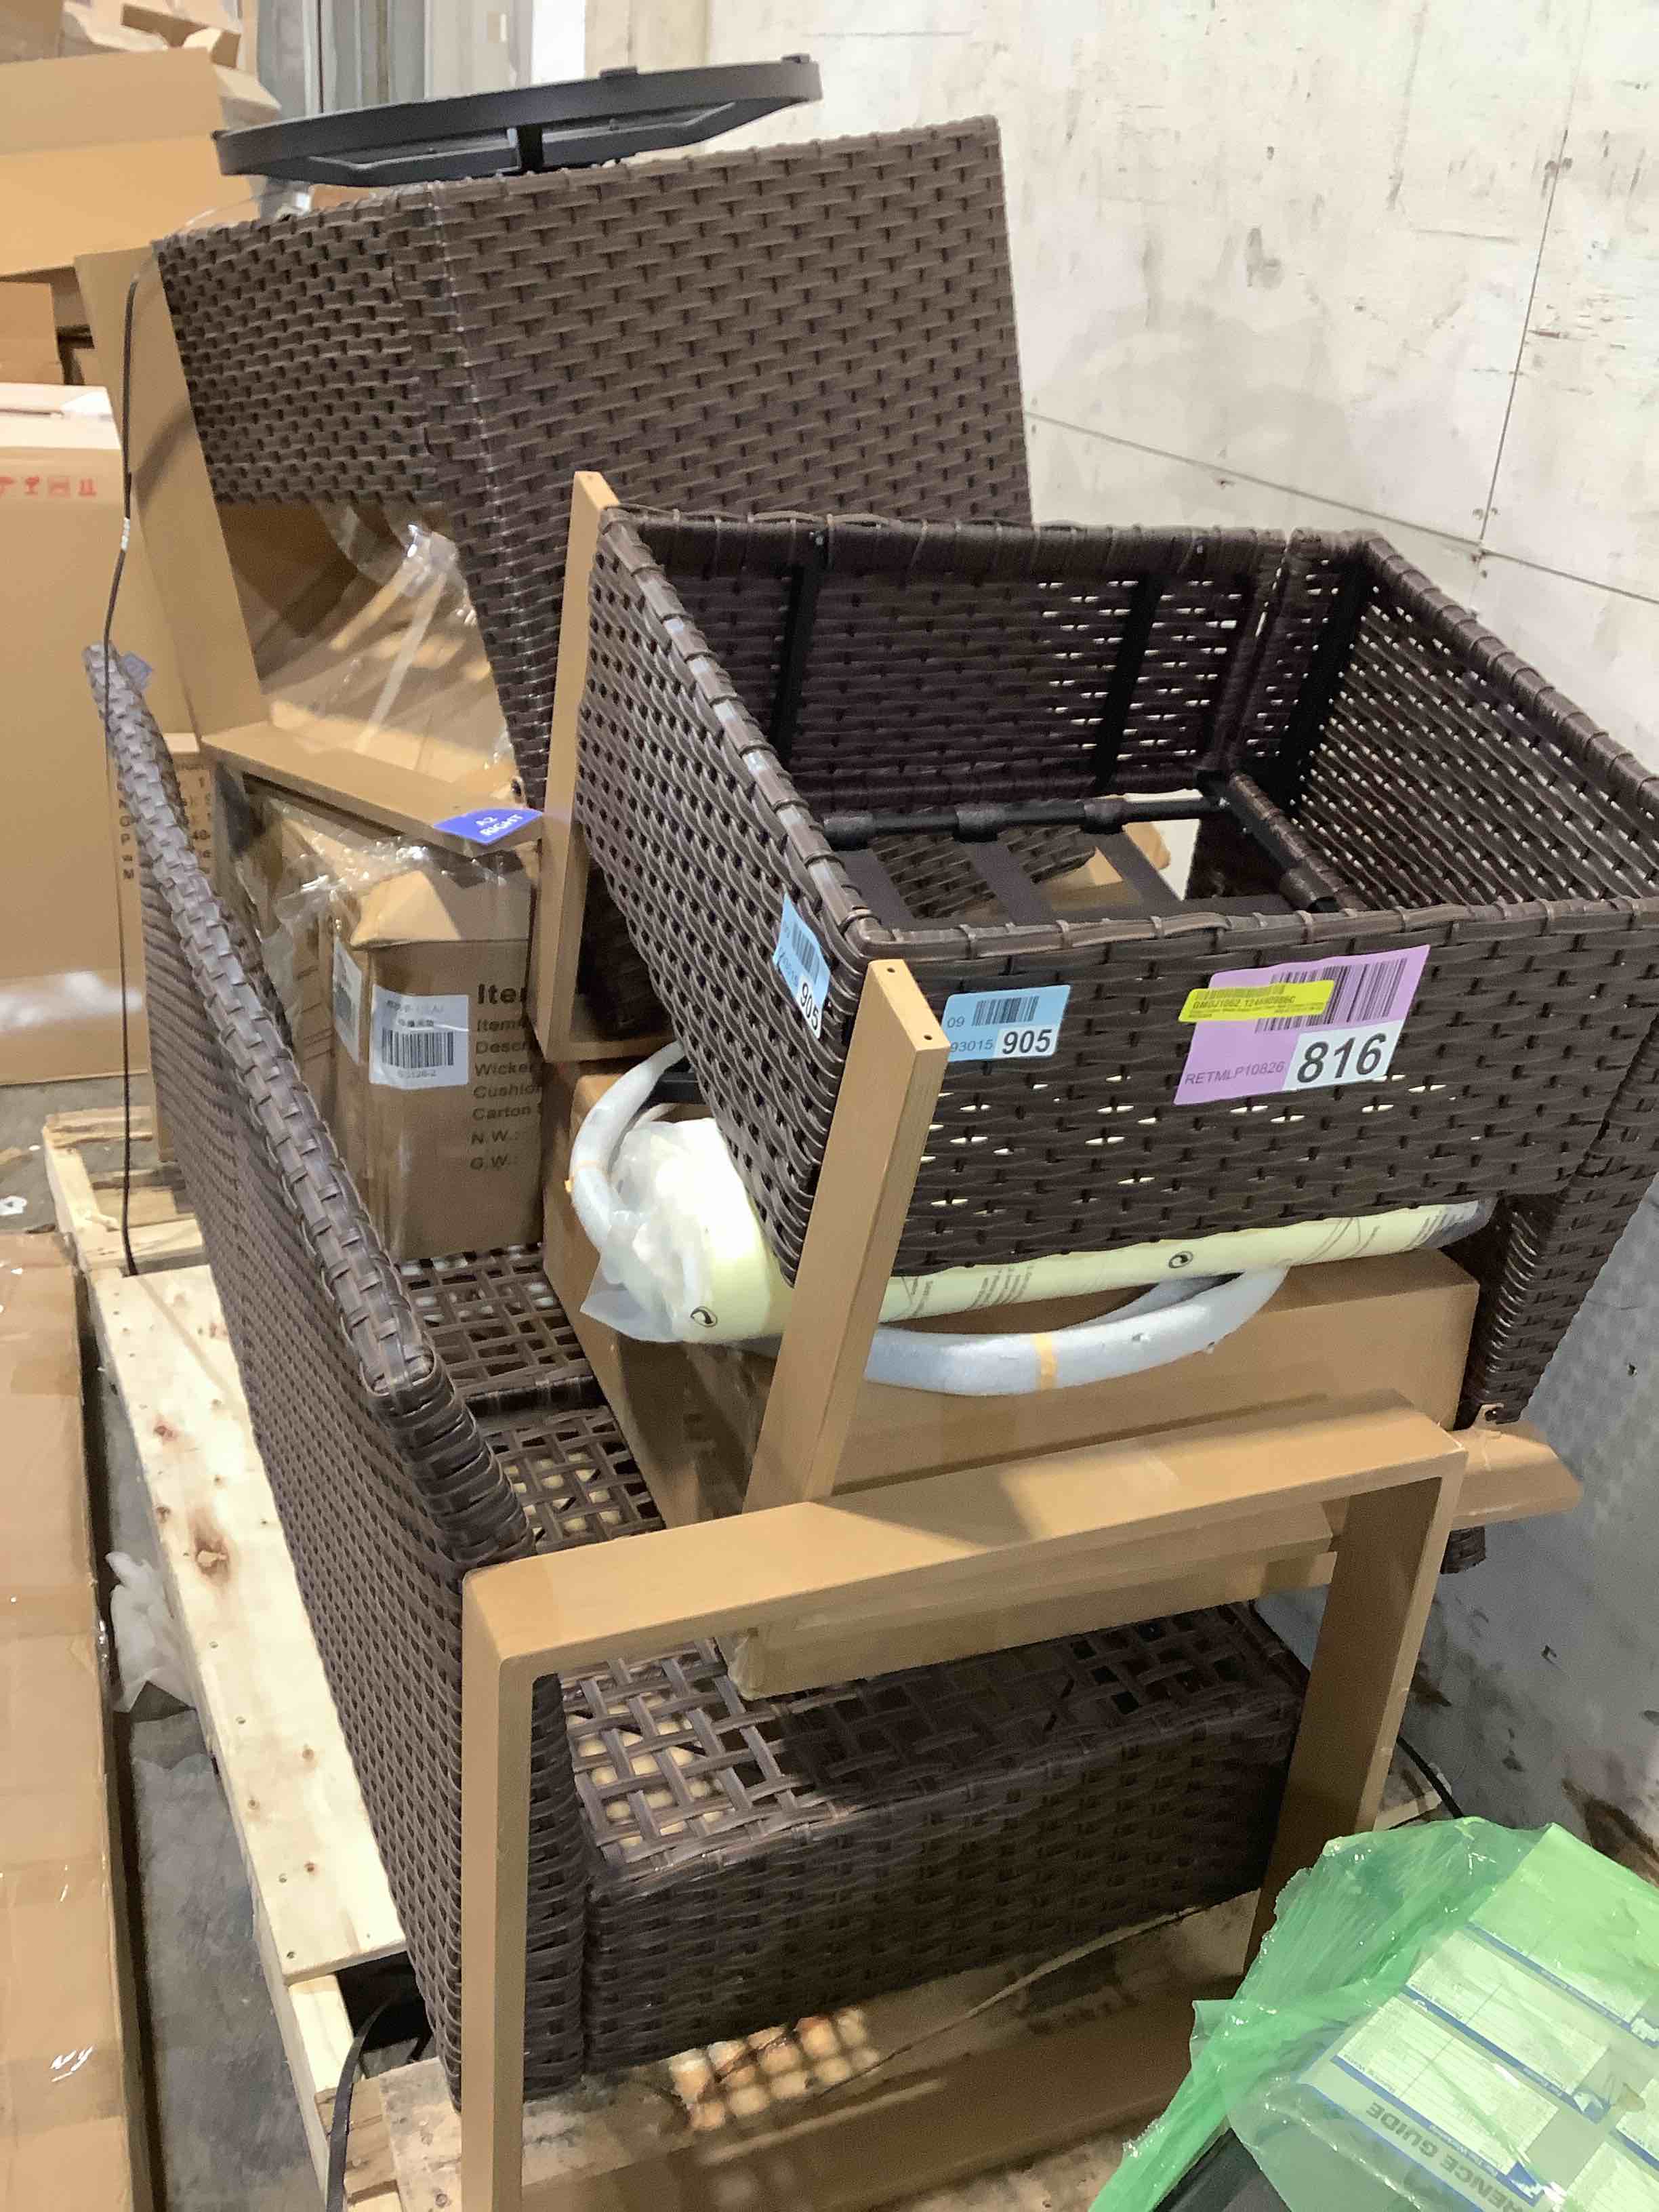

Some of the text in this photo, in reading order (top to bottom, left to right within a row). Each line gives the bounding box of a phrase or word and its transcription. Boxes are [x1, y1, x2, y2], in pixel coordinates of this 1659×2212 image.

[480, 814, 523, 835] RIGHT
[478, 983, 527, 1004] Ite
[800, 982, 819, 1031] 905
[947, 1015, 965, 1028] 09
[1002, 1028, 1053, 1055] 905
[1296, 1033, 1387, 1084] 816
[1366, 2102, 1439, 2158] GUIDE
